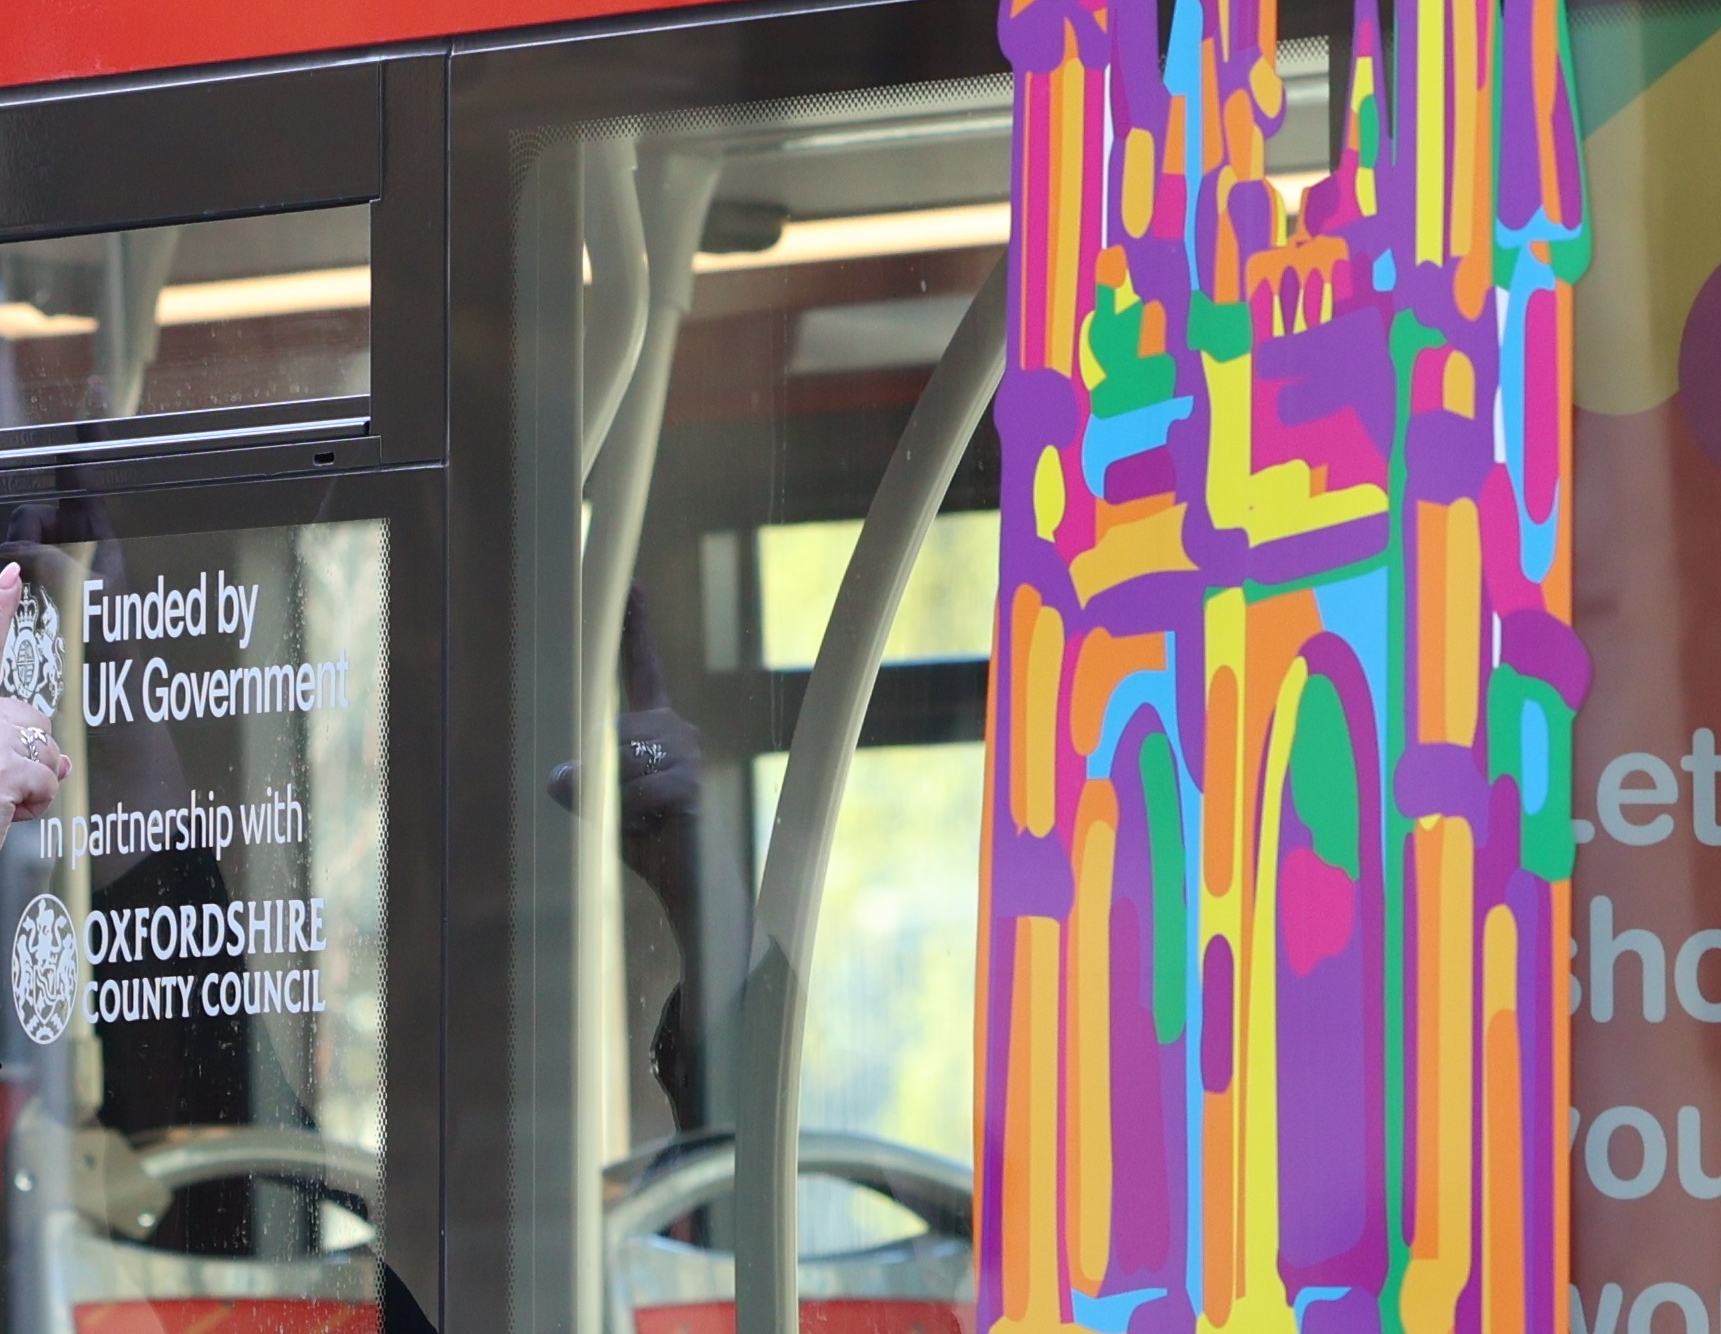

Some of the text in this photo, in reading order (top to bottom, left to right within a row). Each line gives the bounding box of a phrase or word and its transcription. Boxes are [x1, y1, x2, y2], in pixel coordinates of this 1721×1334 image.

[82, 570, 260, 648] Funded by
[82, 648, 349, 727] UK Government
[1573, 727, 1721, 847] et
[71, 789, 234, 870] partnership
[240, 784, 303, 845] with
[83, 897, 328, 966] OXFORDSHIRE
[83, 969, 327, 1024] COUNTY COUNCIL
[1570, 1105, 1721, 1200] ou
